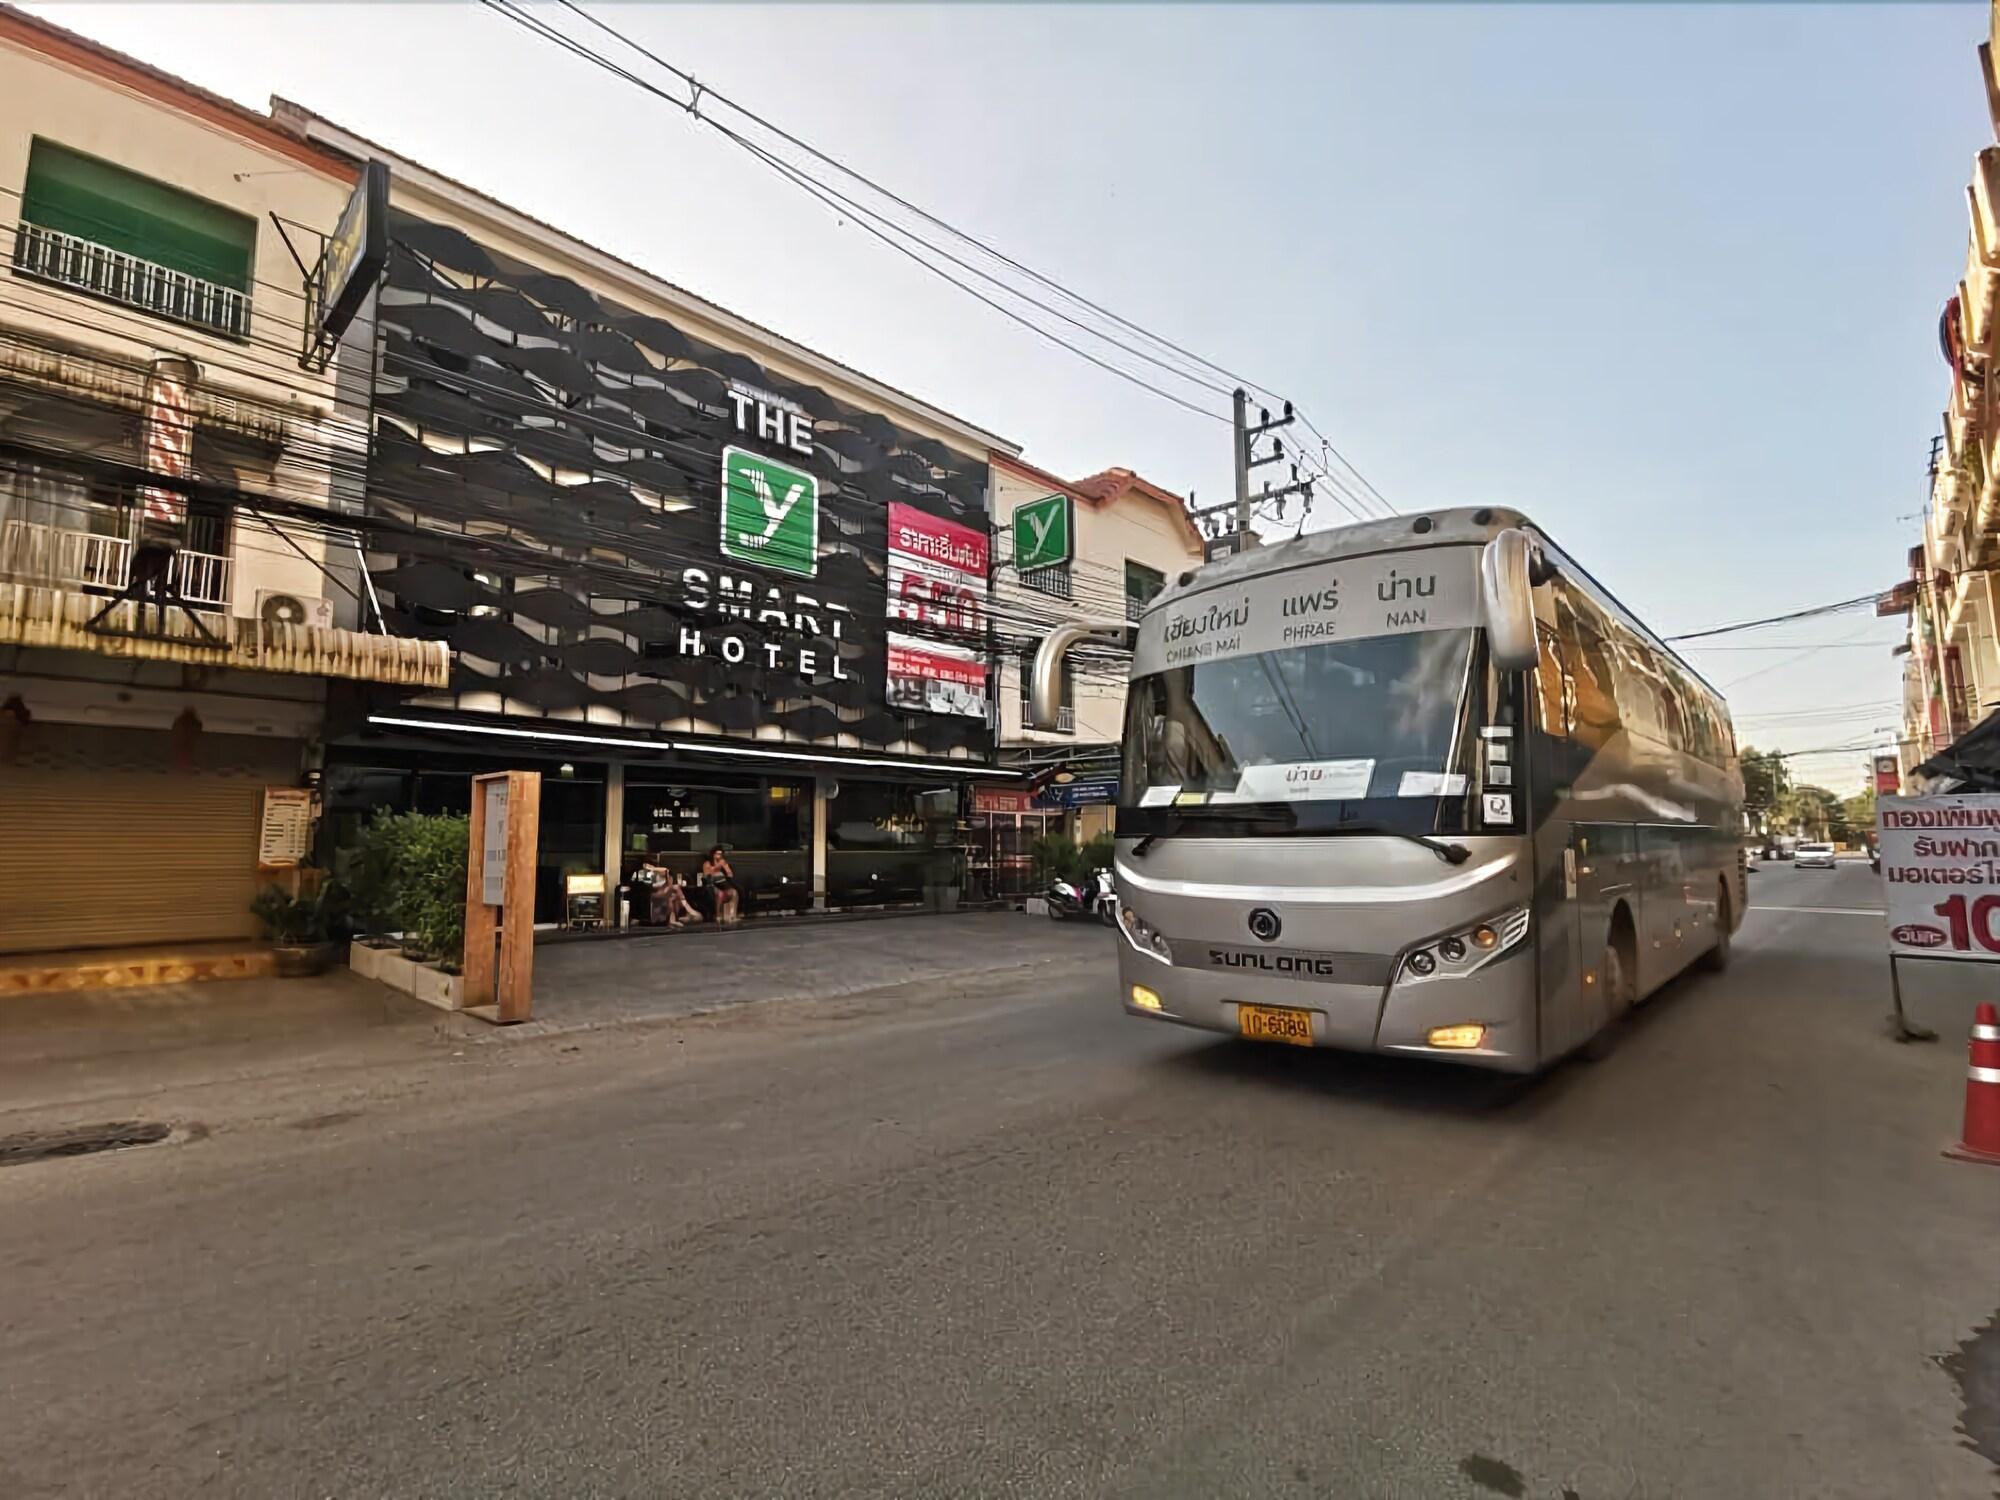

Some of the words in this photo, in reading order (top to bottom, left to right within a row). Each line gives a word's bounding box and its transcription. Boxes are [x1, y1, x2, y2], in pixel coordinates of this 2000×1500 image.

[728, 390, 814, 455] THE
[683, 568, 850, 638] SMART
[1163, 596, 1250, 643] เชียงใหม่
[1283, 578, 1339, 617] แพร่
[1377, 569, 1437, 602] น่าน
[1283, 621, 1336, 642] PHRAE
[1386, 608, 1427, 628] NAN
[680, 627, 848, 679] HOTEL
[1913, 835, 2000, 857] รับฝาก
[1888, 860, 2000, 885] มอเตอร์ไ
[1208, 949, 1334, 976] SUNLONG
